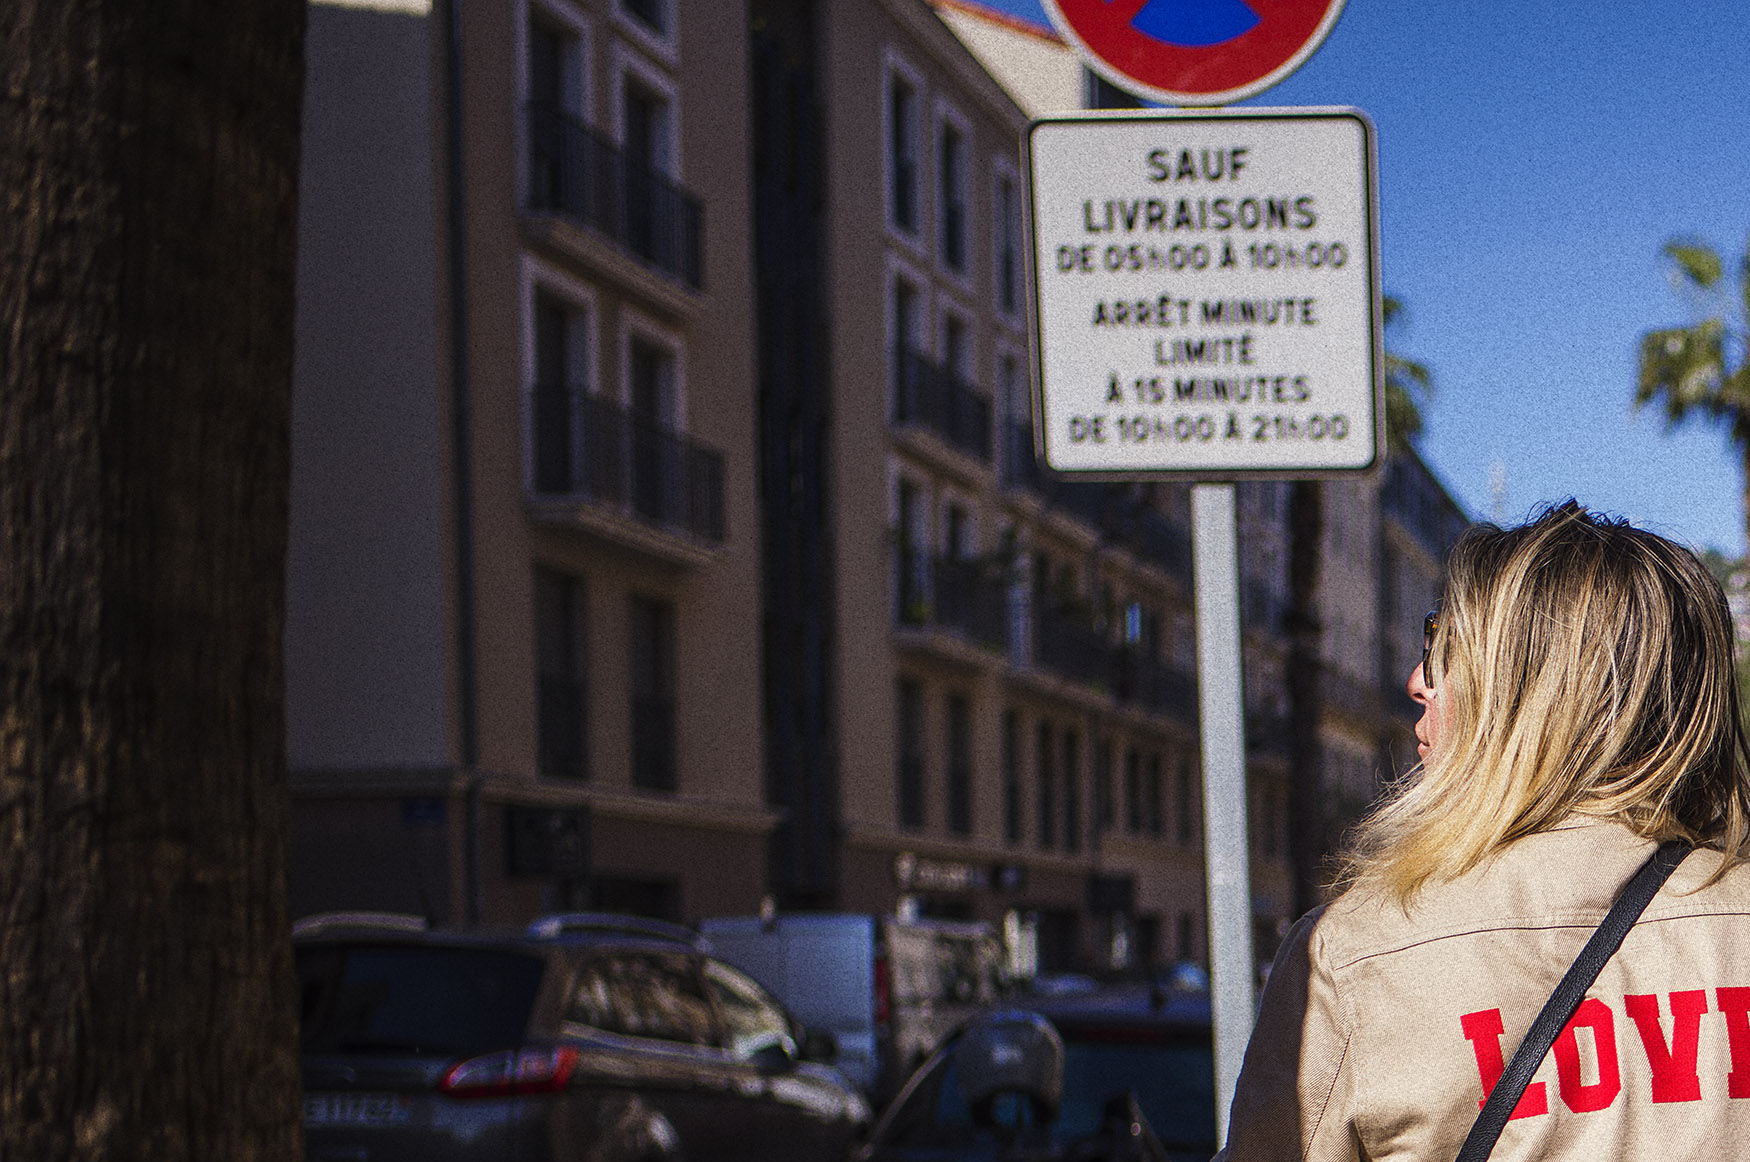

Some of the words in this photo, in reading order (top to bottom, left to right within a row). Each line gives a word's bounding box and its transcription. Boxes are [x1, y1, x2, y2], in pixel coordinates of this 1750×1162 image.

[1147, 147, 1249, 182] SAUF
[1083, 197, 1317, 233] LIVRAISONS
[1057, 245, 1096, 273] DE
[1220, 237, 1236, 270] À
[1248, 242, 1348, 270] 10h00
[1093, 295, 1191, 328] ARRÊT
[1202, 297, 1318, 327] MINUTE
[1154, 333, 1255, 366] LIMITÉ
[1107, 371, 1123, 404] À
[1134, 377, 1165, 404] 15
[1173, 376, 1311, 403] MINUTES
[1069, 417, 1107, 444] DE
[1117, 415, 1215, 443] 10h00
[1225, 411, 1241, 442] À
[1253, 414, 1349, 442] 21h00
